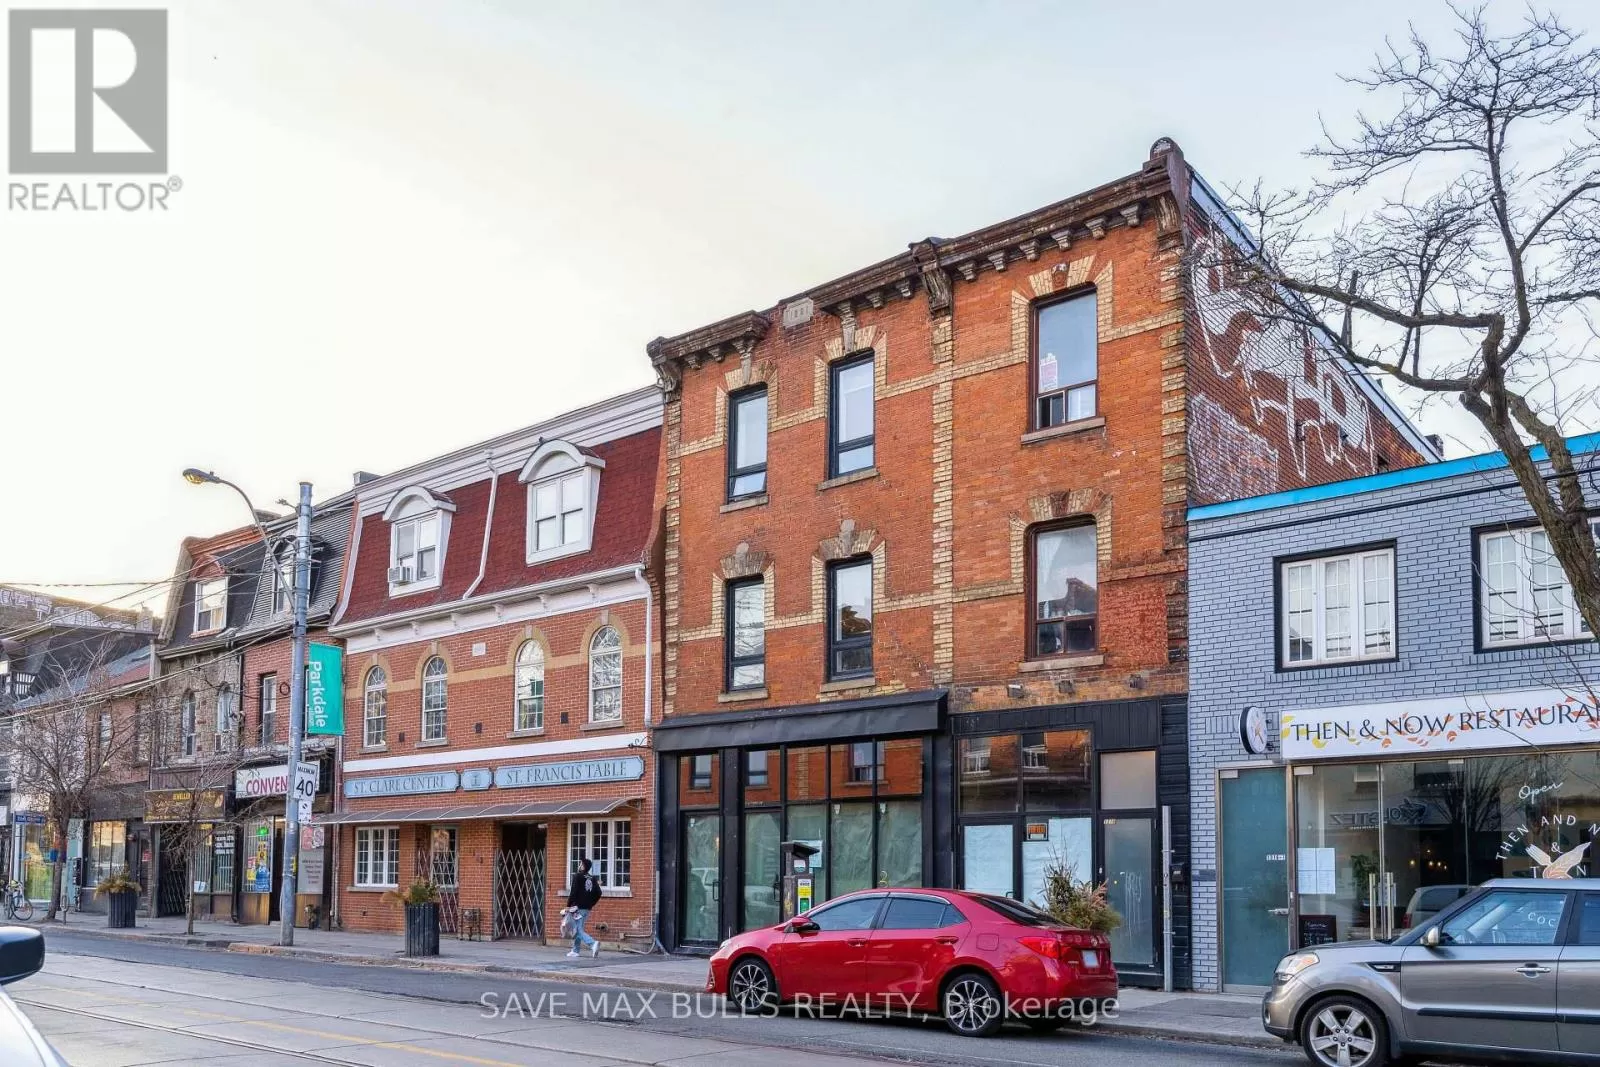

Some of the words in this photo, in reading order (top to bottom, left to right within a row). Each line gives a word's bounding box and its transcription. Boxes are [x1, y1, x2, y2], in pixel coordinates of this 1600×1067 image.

[309, 661, 328, 728] Parkdale
[1290, 721, 1350, 741] THEN
[1359, 719, 1382, 740] &
[1385, 713, 1449, 736] NOW
[1459, 703, 1600, 731] RESTAURA
[507, 769, 522, 785] ST.
[527, 764, 582, 783] FRANCIS
[585, 760, 627, 778] TABLE
[246, 775, 288, 795] CONVEN
[296, 779, 314, 797] 40
[369, 779, 401, 793] CLARE
[403, 775, 445, 791] CENTRE
[1519, 782, 1563, 804] Open
[1495, 824, 1530, 860] THEN
[1541, 814, 1576, 827] AND
[1528, 912, 1556, 927] COC
